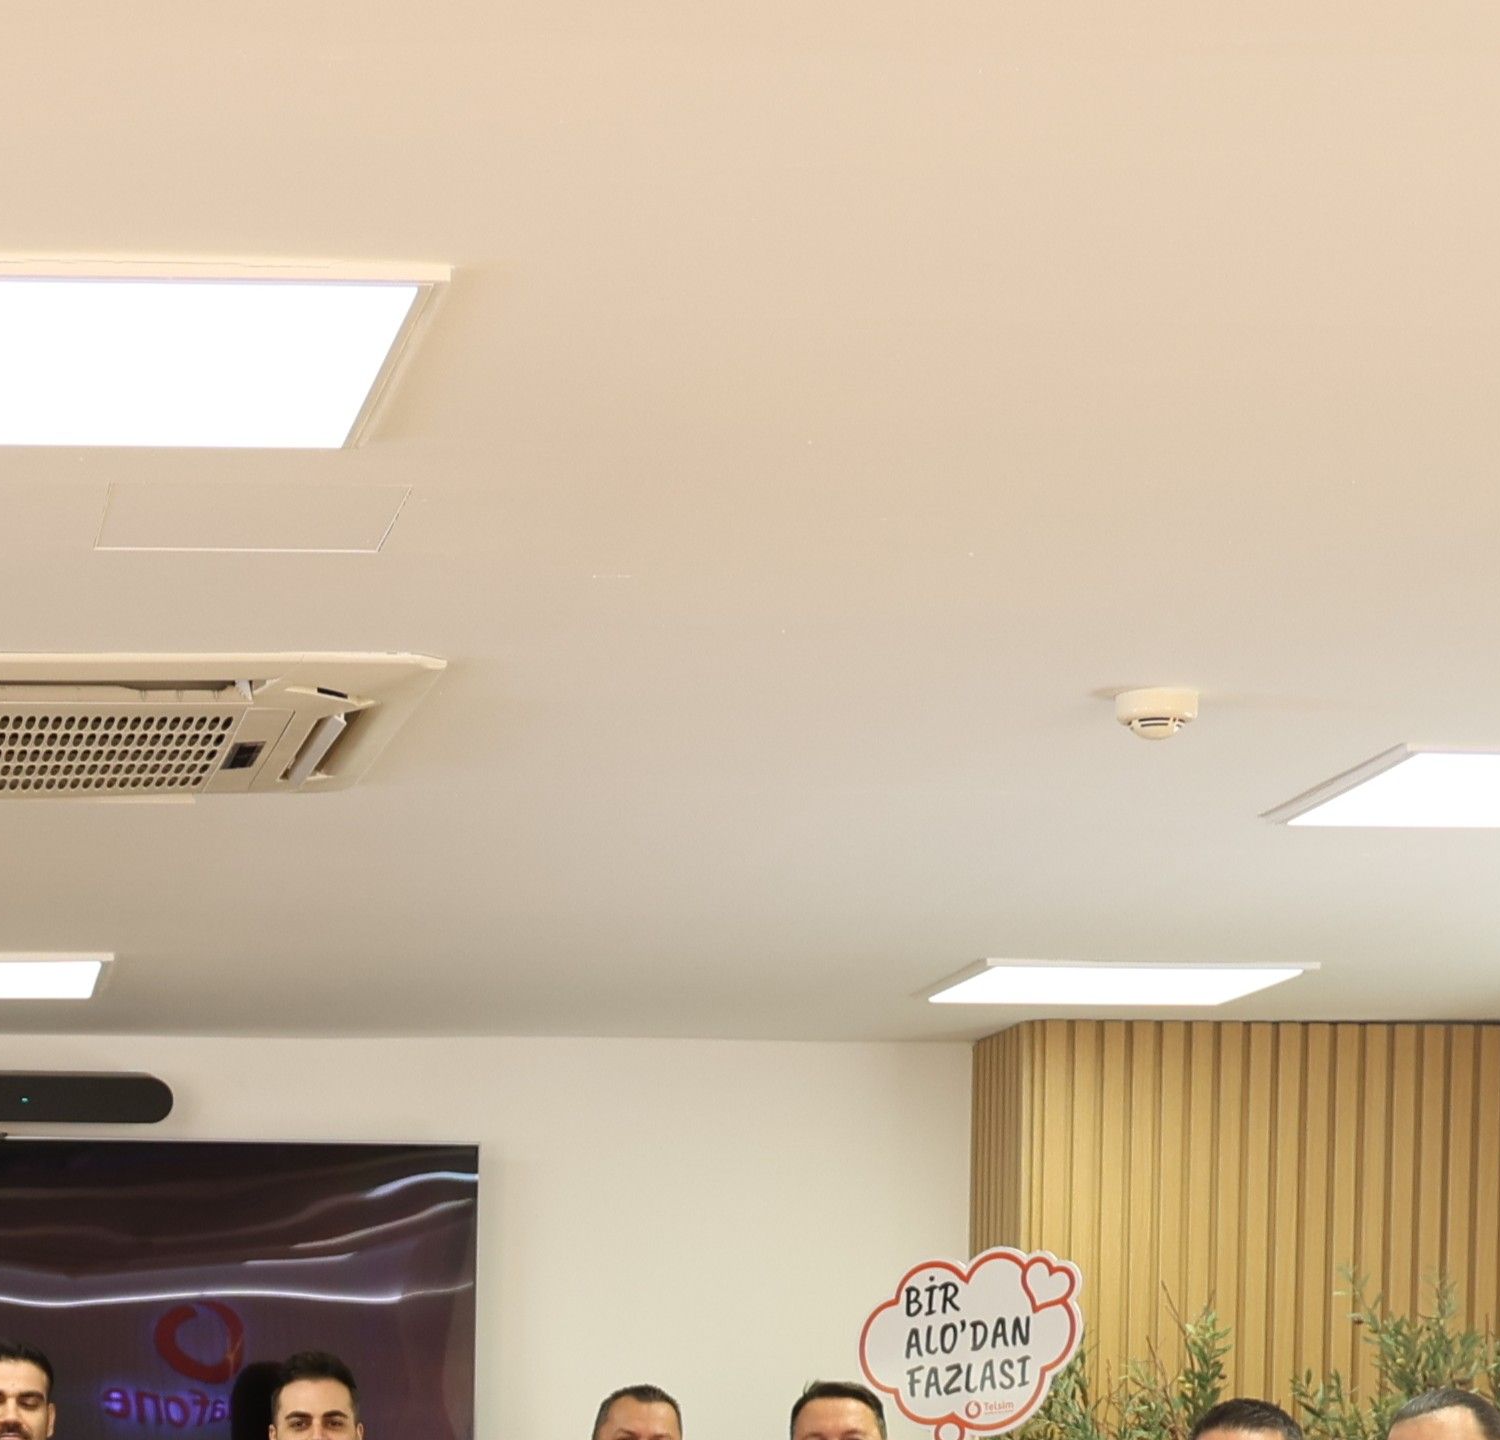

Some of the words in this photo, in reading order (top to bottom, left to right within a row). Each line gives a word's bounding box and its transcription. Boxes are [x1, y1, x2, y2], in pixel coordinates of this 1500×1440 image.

[905, 1275, 960, 1317] BİR
[905, 1315, 1031, 1359] ALO'DAN
[906, 1355, 1031, 1398] FAZLASI
[985, 1400, 1014, 1411] Telsim
